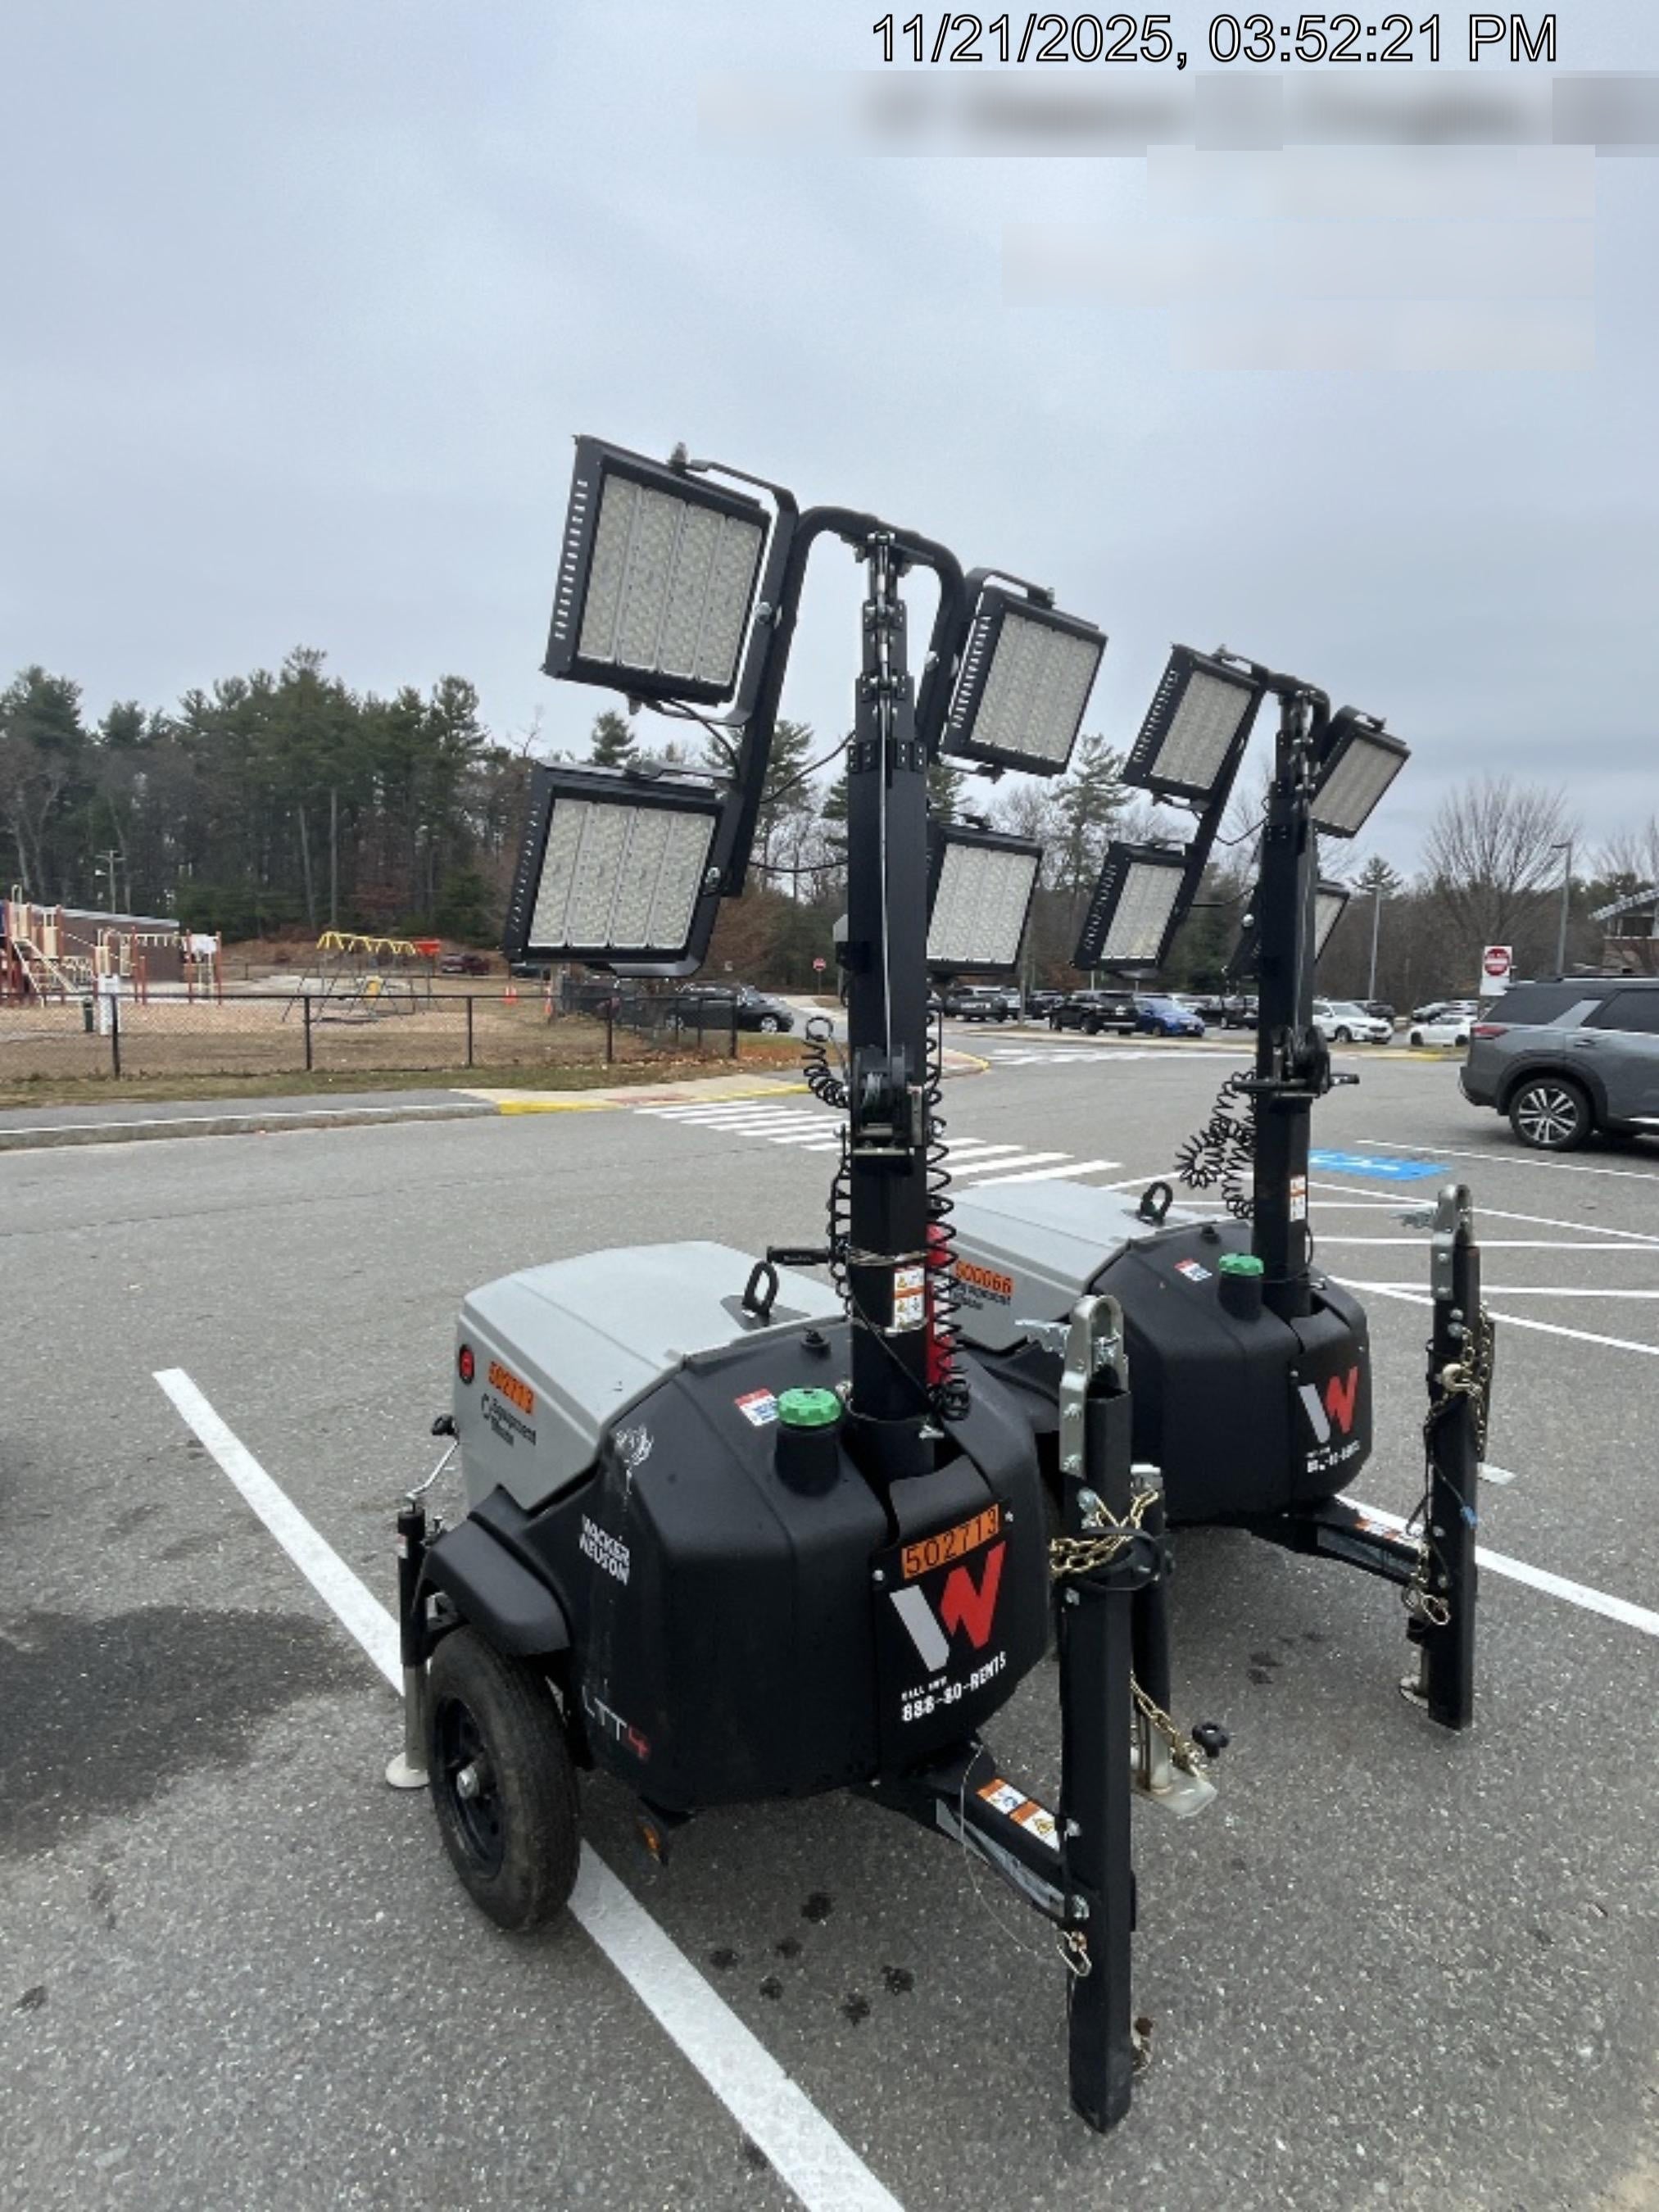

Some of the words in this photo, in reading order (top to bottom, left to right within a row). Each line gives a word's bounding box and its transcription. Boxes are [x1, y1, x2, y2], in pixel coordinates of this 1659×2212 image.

[579, 1533, 630, 1586] NEUSON
[582, 1513, 630, 1566] WACKER
[904, 1507, 998, 1575] 502713
